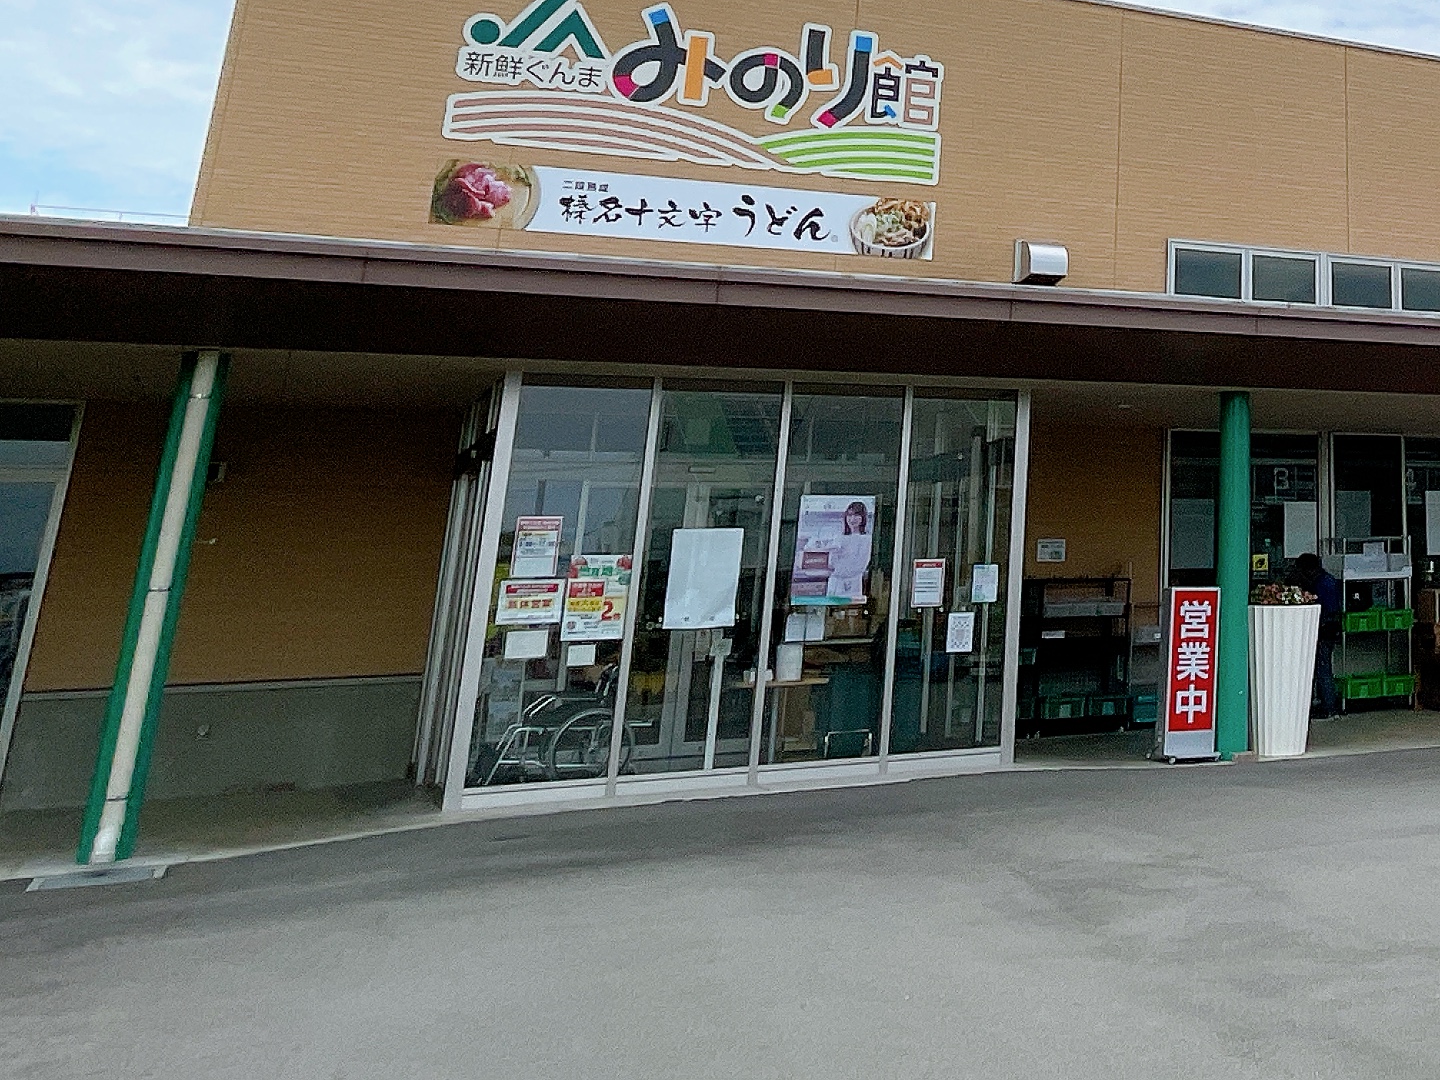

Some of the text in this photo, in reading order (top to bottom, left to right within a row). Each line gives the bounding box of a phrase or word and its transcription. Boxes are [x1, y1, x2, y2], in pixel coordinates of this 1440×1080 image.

[463, 51, 602, 88] 新鮮ぐんま
[613, 8, 939, 127] みのり館
[1175, 600, 1211, 724] 営業中
